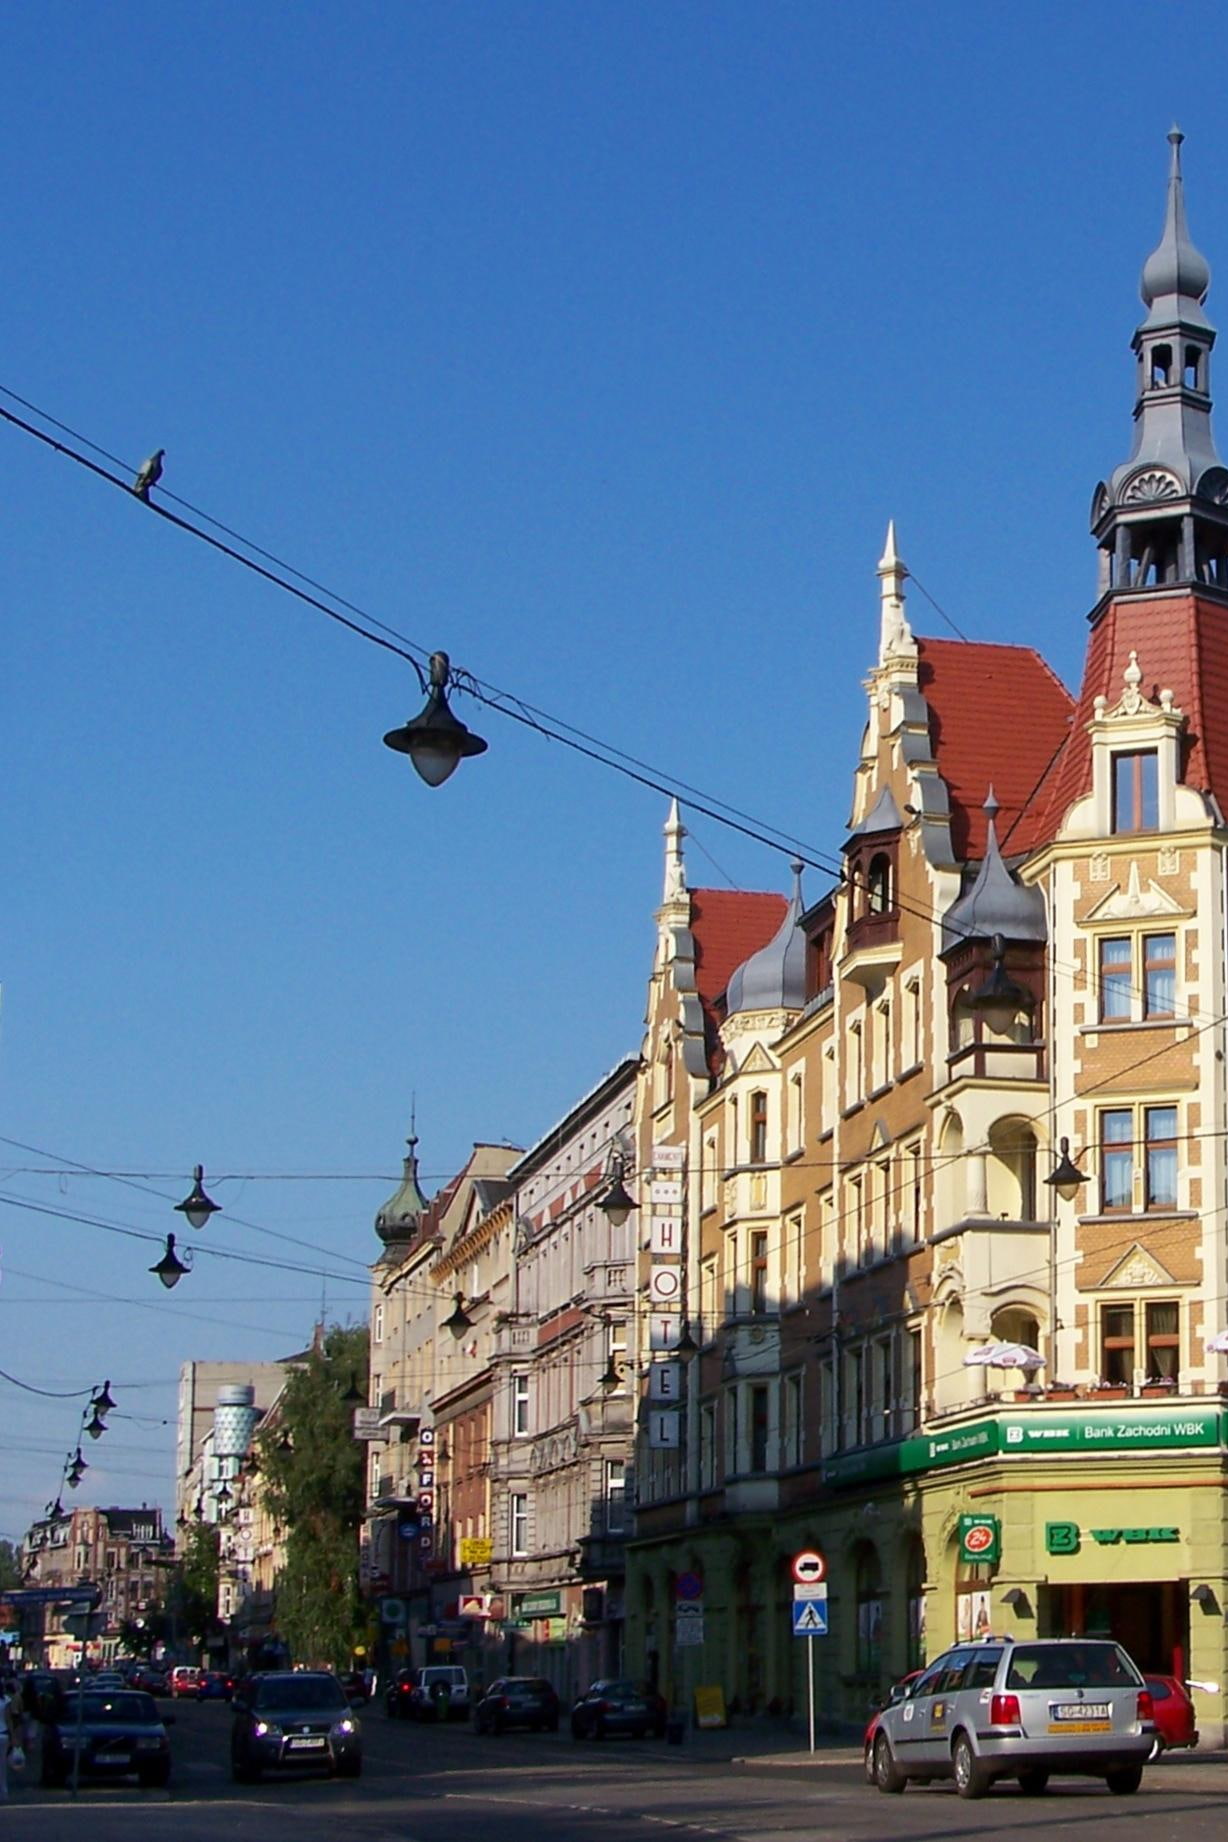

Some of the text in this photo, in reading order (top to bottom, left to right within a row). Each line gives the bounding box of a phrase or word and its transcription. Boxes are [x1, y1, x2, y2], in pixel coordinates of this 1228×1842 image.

[654, 1222, 679, 1443] HOTEL
[1084, 1425, 1115, 1440] Bank
[1116, 1424, 1172, 1439] Zachodni
[1173, 1422, 1205, 1436] WBK
[968, 1529, 988, 1546] 24
[1089, 1527, 1181, 1545] WBK
